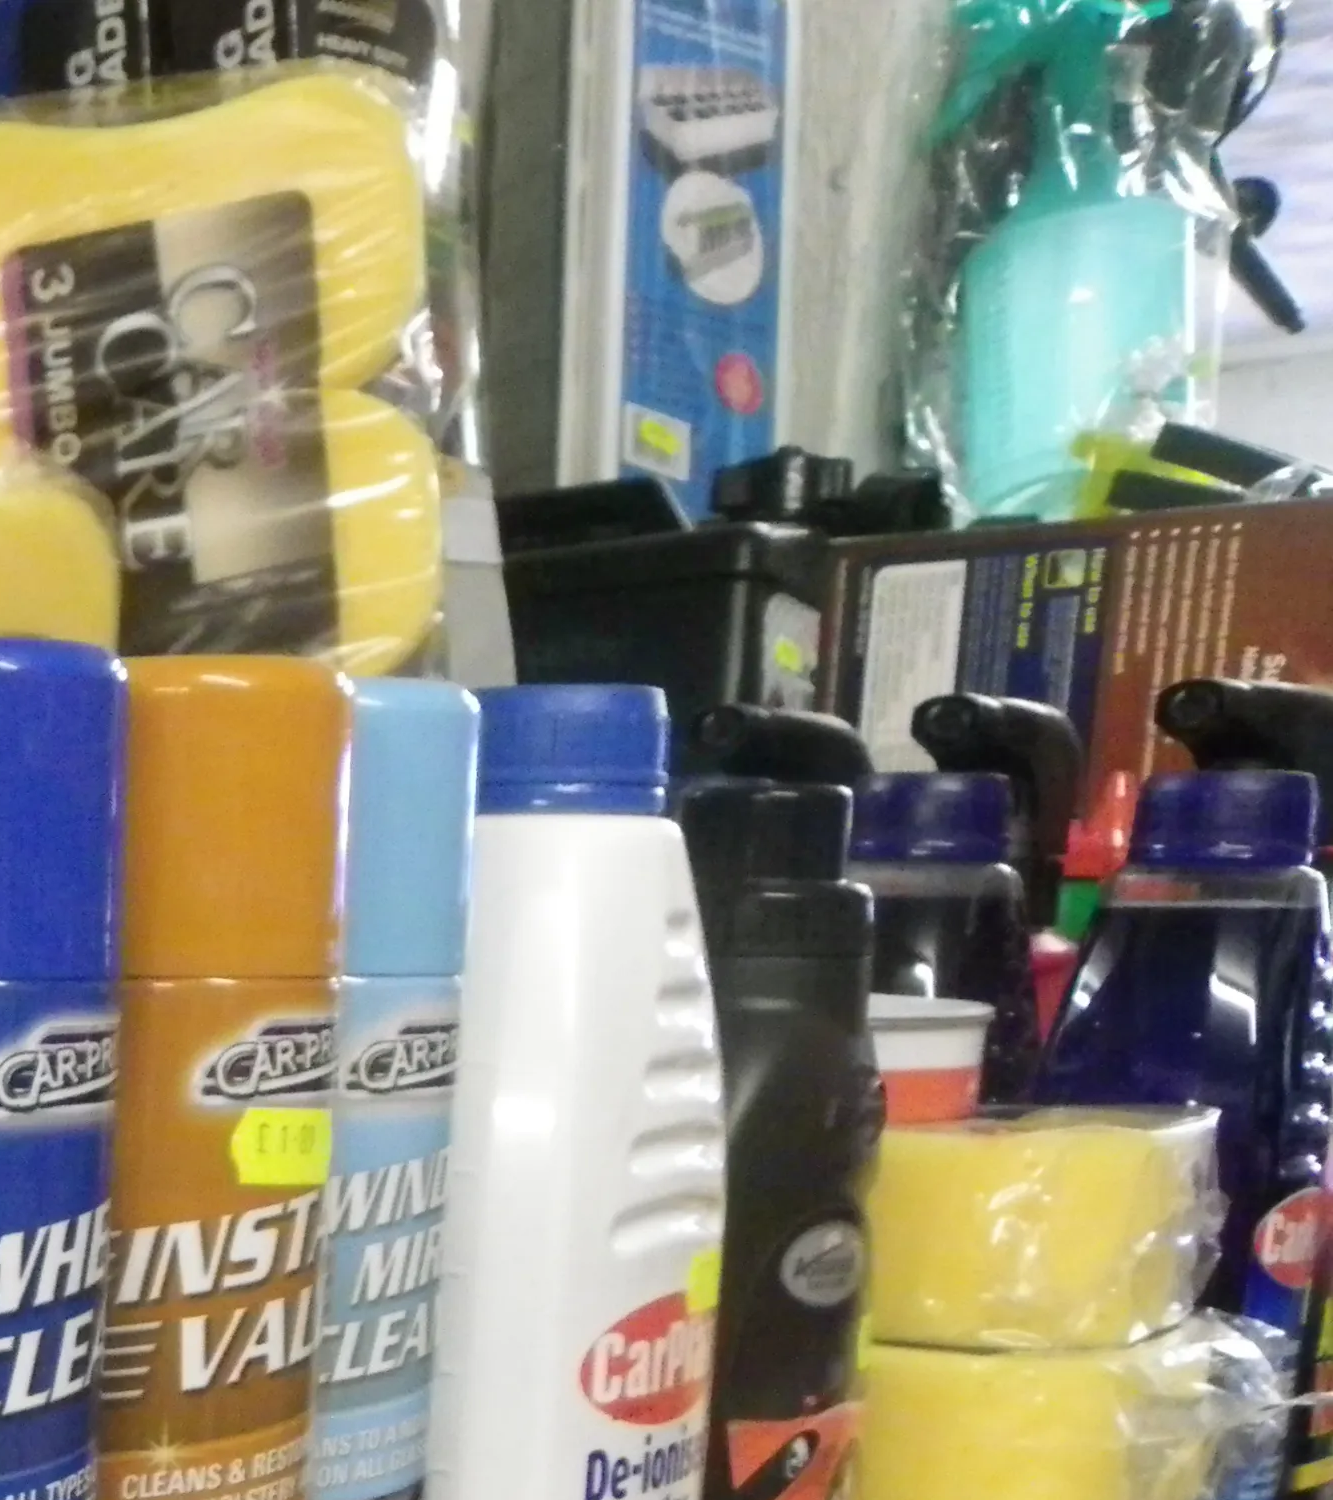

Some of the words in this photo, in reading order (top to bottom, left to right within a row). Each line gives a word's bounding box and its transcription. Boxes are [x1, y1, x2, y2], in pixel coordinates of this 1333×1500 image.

[30, 263, 76, 303] 3
[31, 316, 82, 466] JUMBO
[93, 311, 194, 572] CARE
[227, 1456, 245, 1484] &
